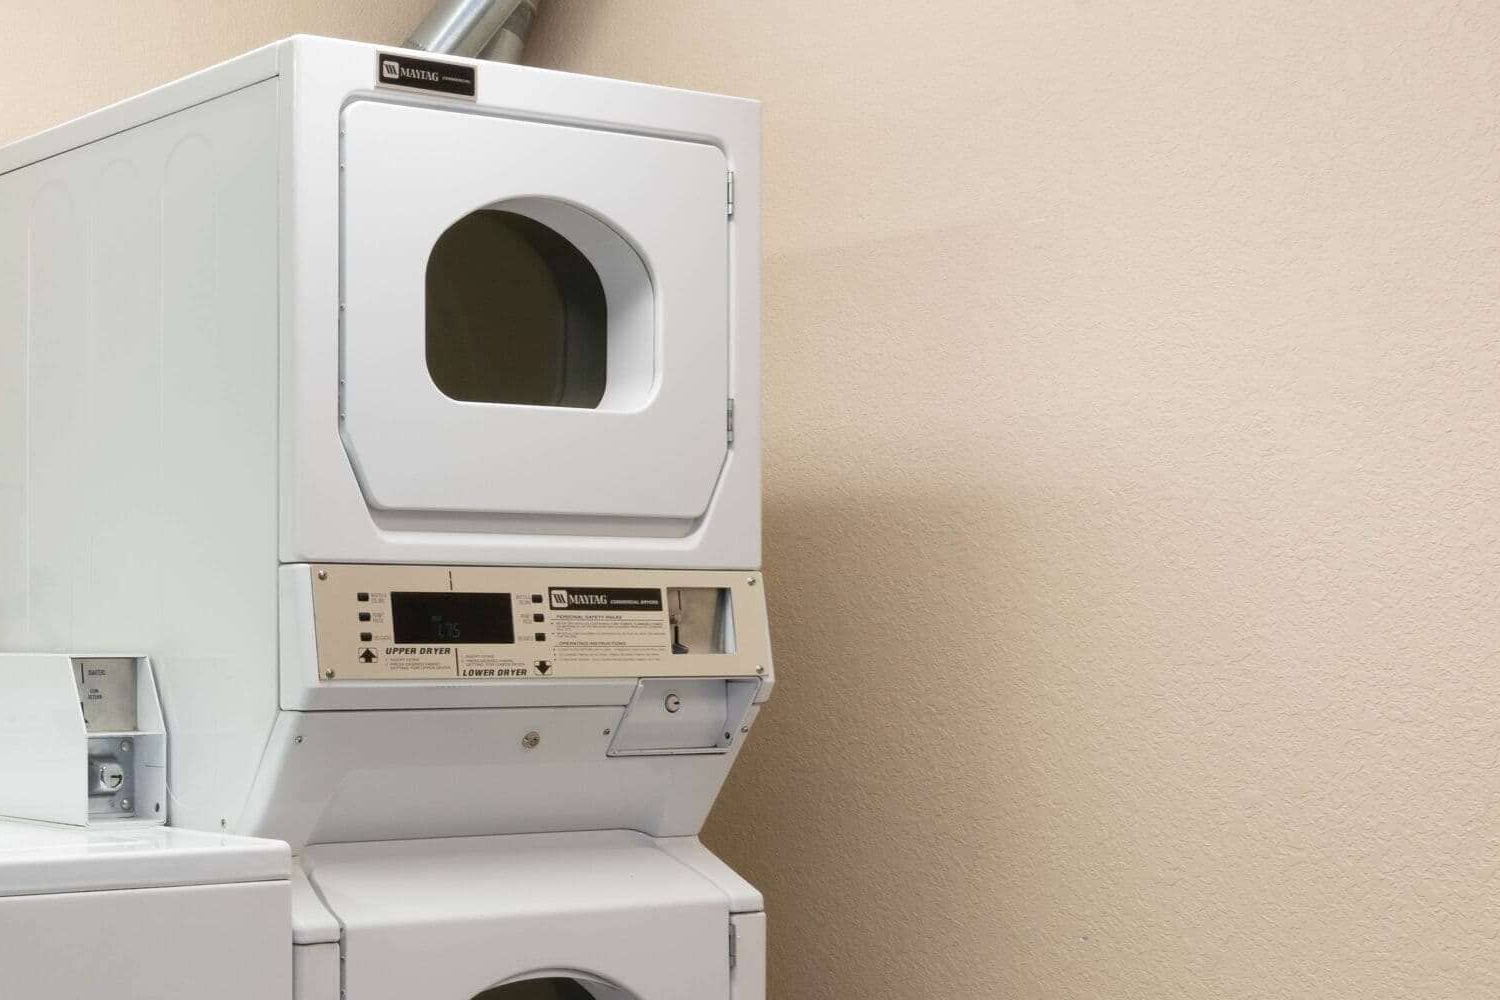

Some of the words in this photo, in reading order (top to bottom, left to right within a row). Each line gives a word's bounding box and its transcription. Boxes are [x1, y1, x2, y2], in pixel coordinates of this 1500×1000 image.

[400, 67, 439, 82] MAYTAG
[569, 594, 607, 605] MAYTAG
[385, 647, 417, 655] UPPER
[419, 647, 451, 655] DRYER
